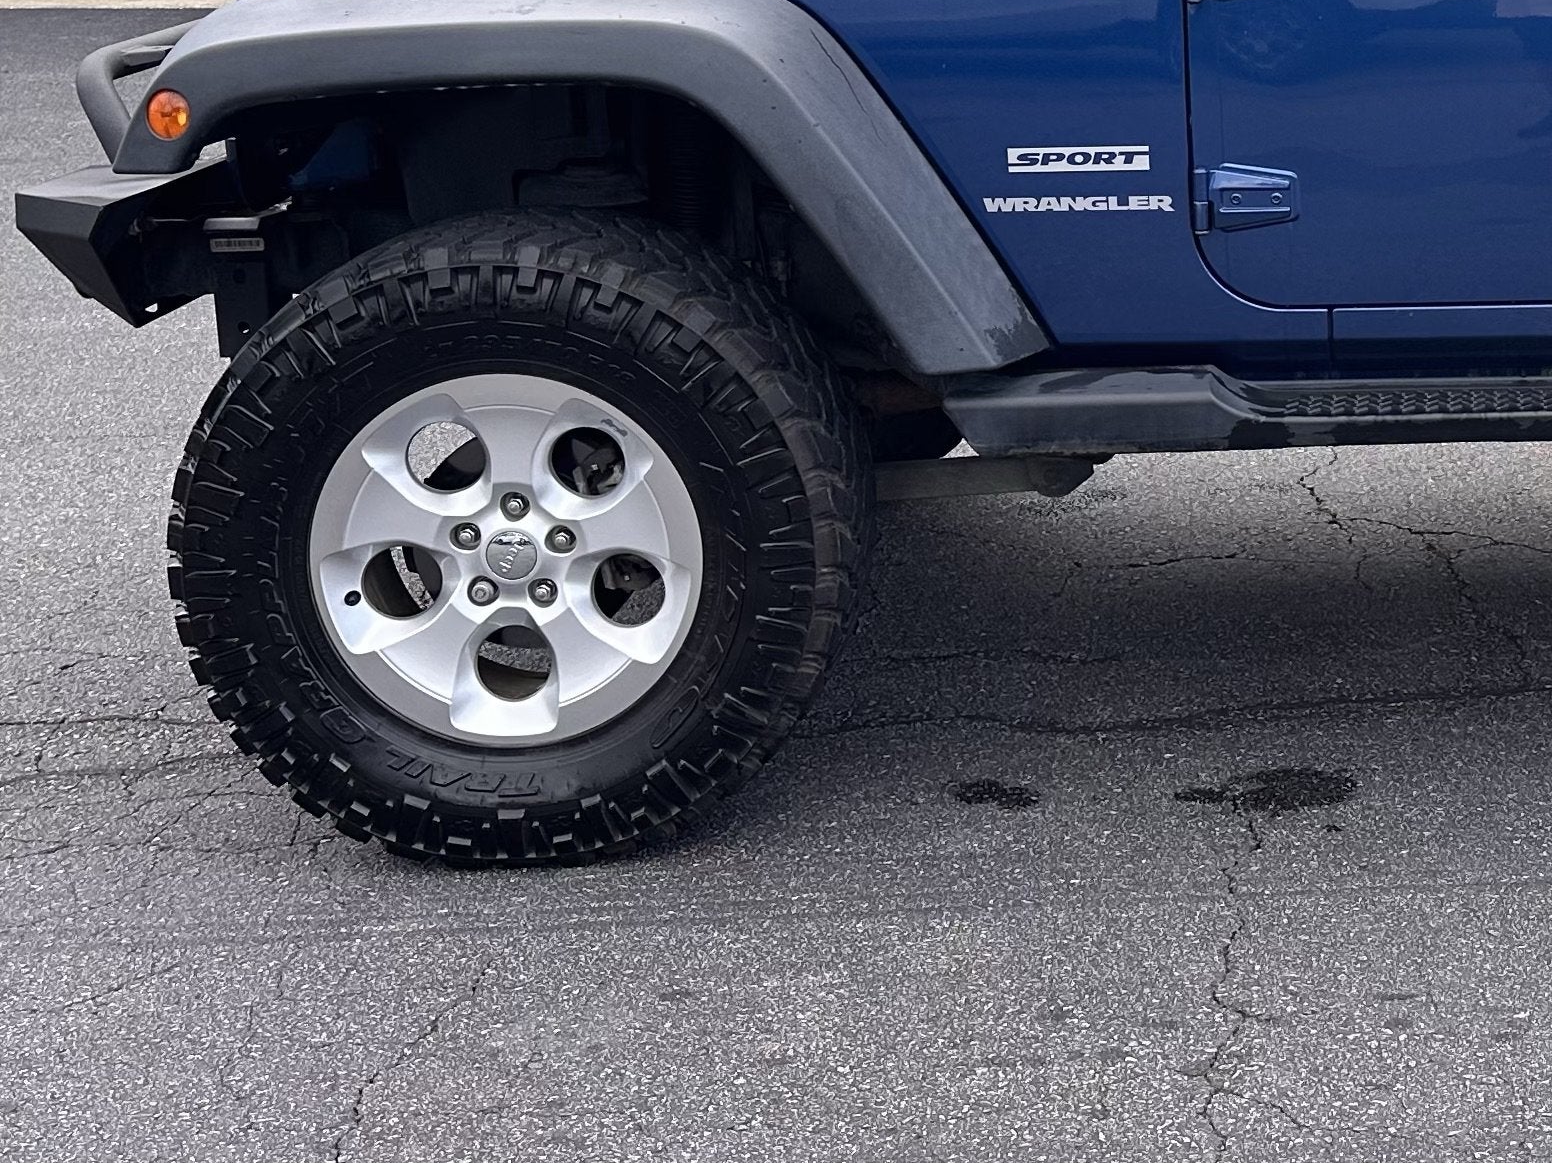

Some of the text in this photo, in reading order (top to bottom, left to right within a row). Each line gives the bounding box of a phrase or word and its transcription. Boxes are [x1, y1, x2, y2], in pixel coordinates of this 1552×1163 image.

[1012, 150, 1145, 167] SPORT
[982, 194, 1177, 213] WRANGLER
[380, 747, 543, 799] TRAIL
